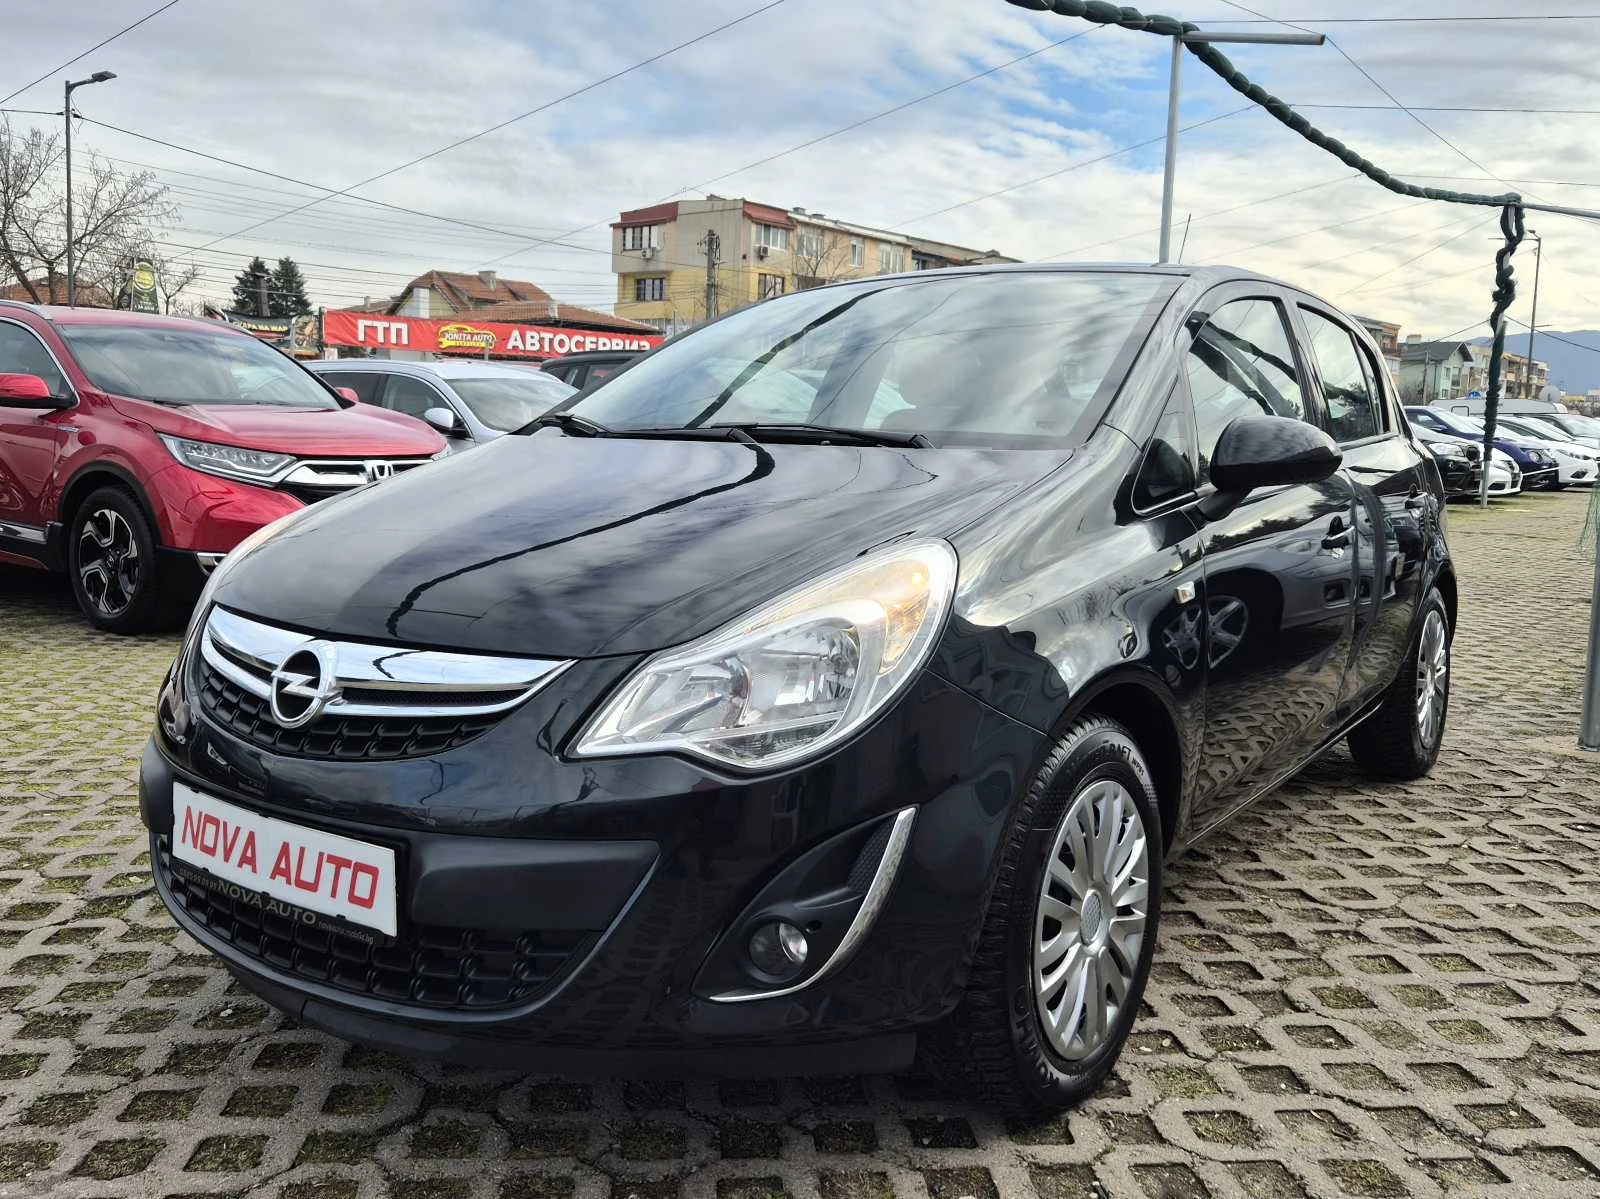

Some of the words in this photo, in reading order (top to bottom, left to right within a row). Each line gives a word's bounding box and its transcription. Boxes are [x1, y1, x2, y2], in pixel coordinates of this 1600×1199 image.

[357, 319, 408, 345] ГТП
[472, 334, 493, 344] AUTO
[181, 805, 257, 874] NOVA
[269, 840, 380, 910] AUTO
[217, 881, 263, 909] NOVA
[265, 901, 317, 925] AUTO
